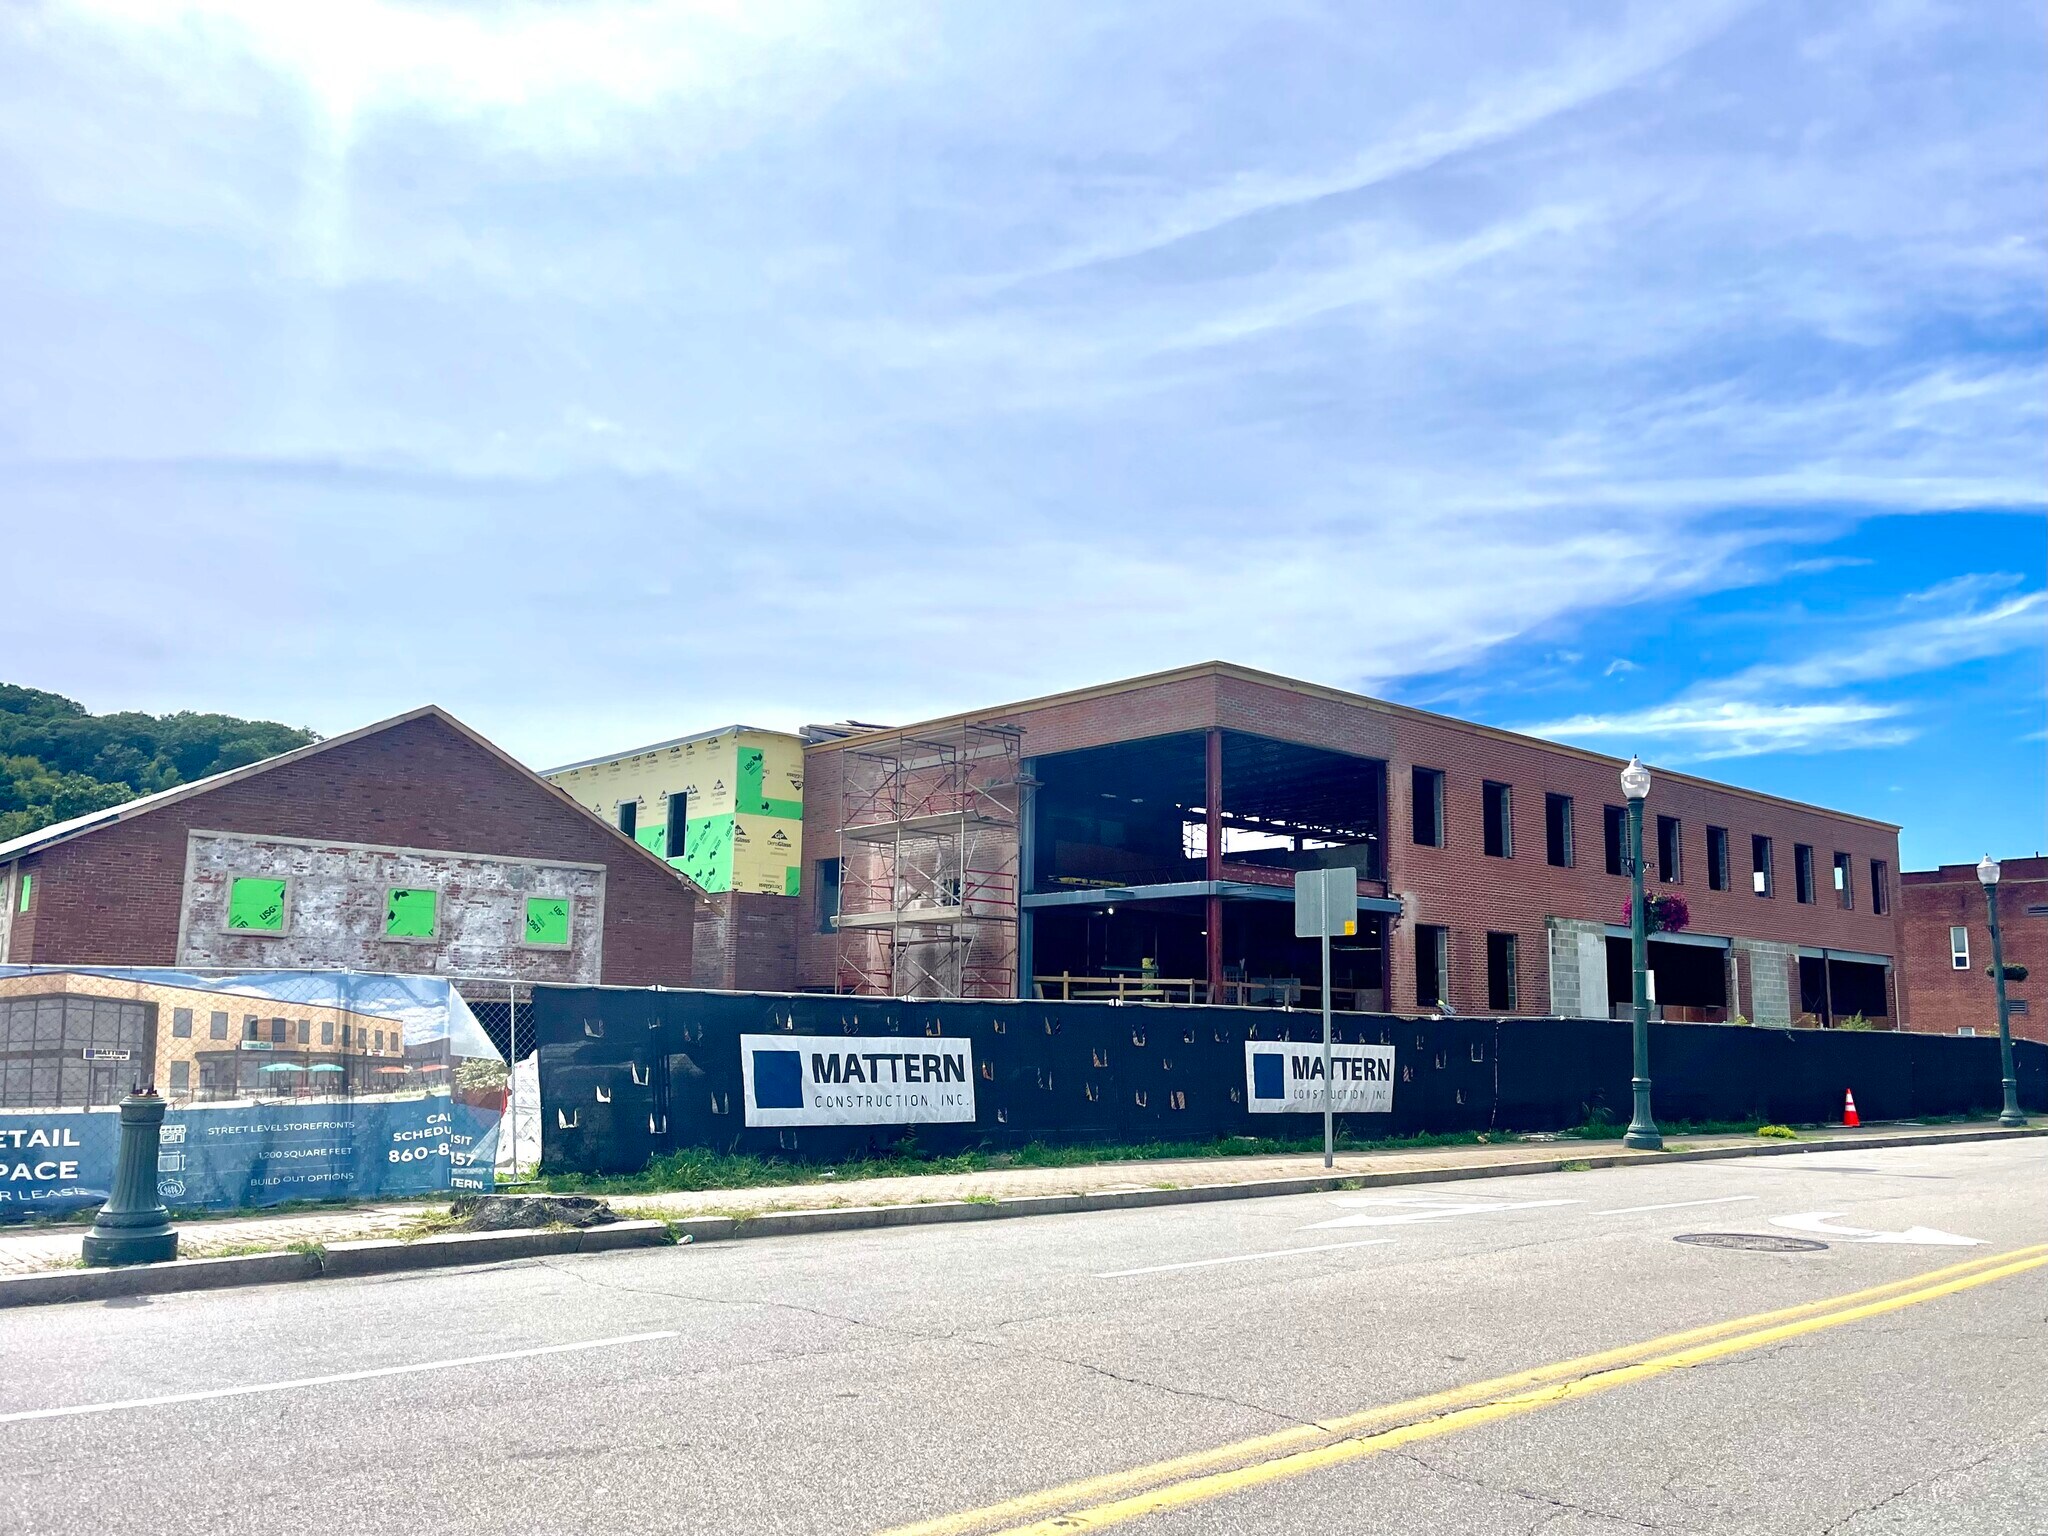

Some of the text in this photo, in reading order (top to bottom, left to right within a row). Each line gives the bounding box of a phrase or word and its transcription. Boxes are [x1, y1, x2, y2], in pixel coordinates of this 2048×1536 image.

[744, 760, 756, 771] USG
[258, 905, 277, 921] USG
[528, 919, 542, 934] USG
[811, 1053, 966, 1084] MATTERN
[941, 1093, 970, 1107] INC.
[1293, 1089, 1368, 1100] CONSTUCTION,
[208, 1121, 355, 1136] STREET LEVEL STOREFRONTS
[258, 1147, 353, 1160] 1,200 SQUARE FEET
[250, 1172, 355, 1187] BUILD OUT OPTIONS
[18, 1186, 88, 1201] LEASE
